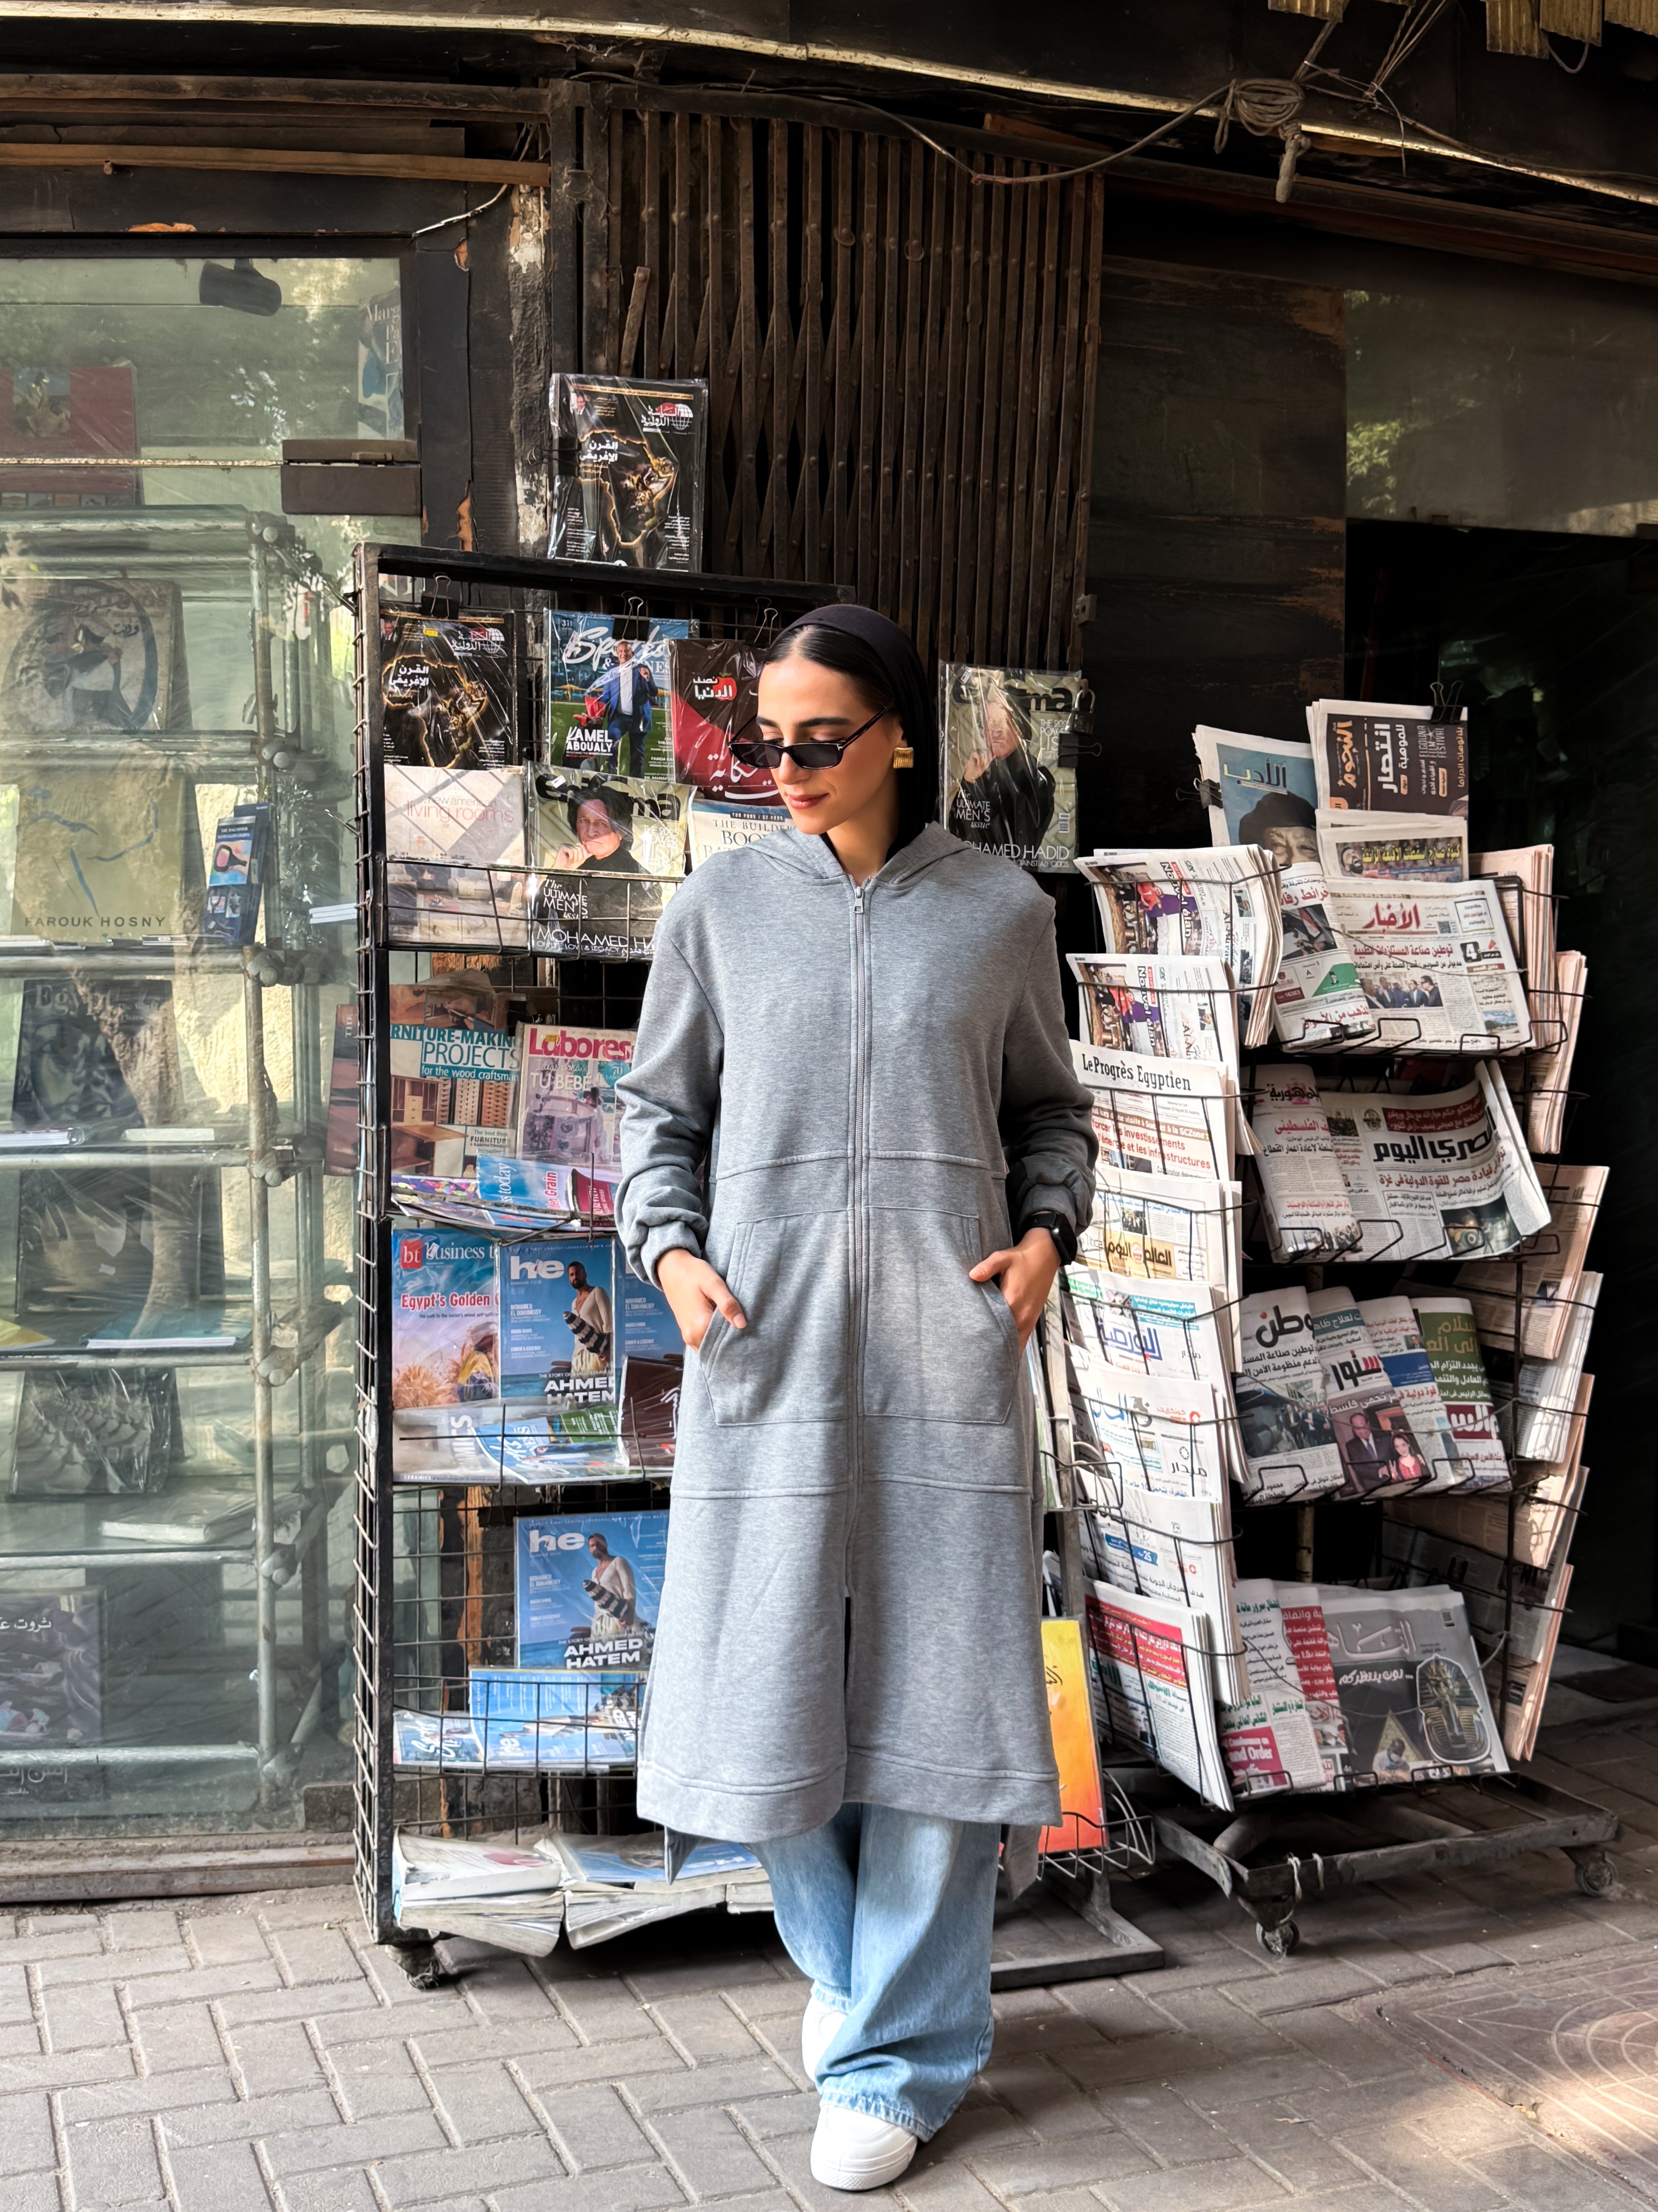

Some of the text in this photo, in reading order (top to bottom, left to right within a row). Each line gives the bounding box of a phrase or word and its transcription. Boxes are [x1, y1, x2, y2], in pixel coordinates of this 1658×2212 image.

[589, 440, 618, 452] القرن
[399, 664, 429, 674] القرن
[694, 685, 733, 700] الدنيا
[1040, 718, 1053, 727] THE
[566, 727, 613, 744] KAMEL
[1040, 736, 1059, 751] LIS
[1436, 727, 1447, 758] FESTIVAL
[566, 741, 613, 752] ABOUALY
[1428, 741, 1437, 758] FILM
[1374, 723, 1398, 794] انتصار
[407, 800, 514, 822] living rooms
[956, 800, 991, 810] ULTIMATE
[713, 819, 736, 829] THE
[956, 809, 991, 822] MEN'S
[659, 828, 679, 837] 2025
[971, 821, 991, 829] issue
[1023, 845, 1070, 860] HADID
[1040, 860, 1050, 868] ALL
[544, 879, 562, 889] The
[544, 887, 587, 903] ULTIMATE
[25, 916, 166, 927] FAROUK HOSNY
[1362, 902, 1421, 933] الأخبار
[537, 926, 628, 948] MOHAMED
[36, 984, 114, 1016] Egypt
[390, 1025, 517, 1048] RNITURE-MAKIN
[529, 1028, 631, 1061] Labores
[423, 1041, 521, 1070] PROJECTS
[422, 1066, 433, 1075] for
[436, 1067, 449, 1077] the
[451, 1068, 476, 1079] wood
[612, 1067, 623, 1075] 70
[1082, 1053, 1191, 1091] Le Progrès Egyptien
[530, 1073, 552, 1089] TU
[1125, 1115, 1141, 1126] visite
[1179, 1127, 1204, 1140] SCZone
[1124, 1127, 1185, 1150] investissements
[1127, 1142, 1135, 1152] et
[1137, 1143, 1147, 1155] les
[1373, 1135, 1428, 1164] اليوم
[493, 1163, 517, 1194] today
[543, 1171, 558, 1198] Grain
[404, 1242, 485, 1263] bt business
[510, 1255, 565, 1280] he
[401, 1291, 491, 1312] Egypt's Golden
[1267, 1350, 1290, 1359] صناعة
[529, 1529, 585, 1553] he
[563, 1638, 643, 1658] AHMED
[566, 1650, 640, 1670] HATEM
[1248, 1746, 1272, 1760] Order
